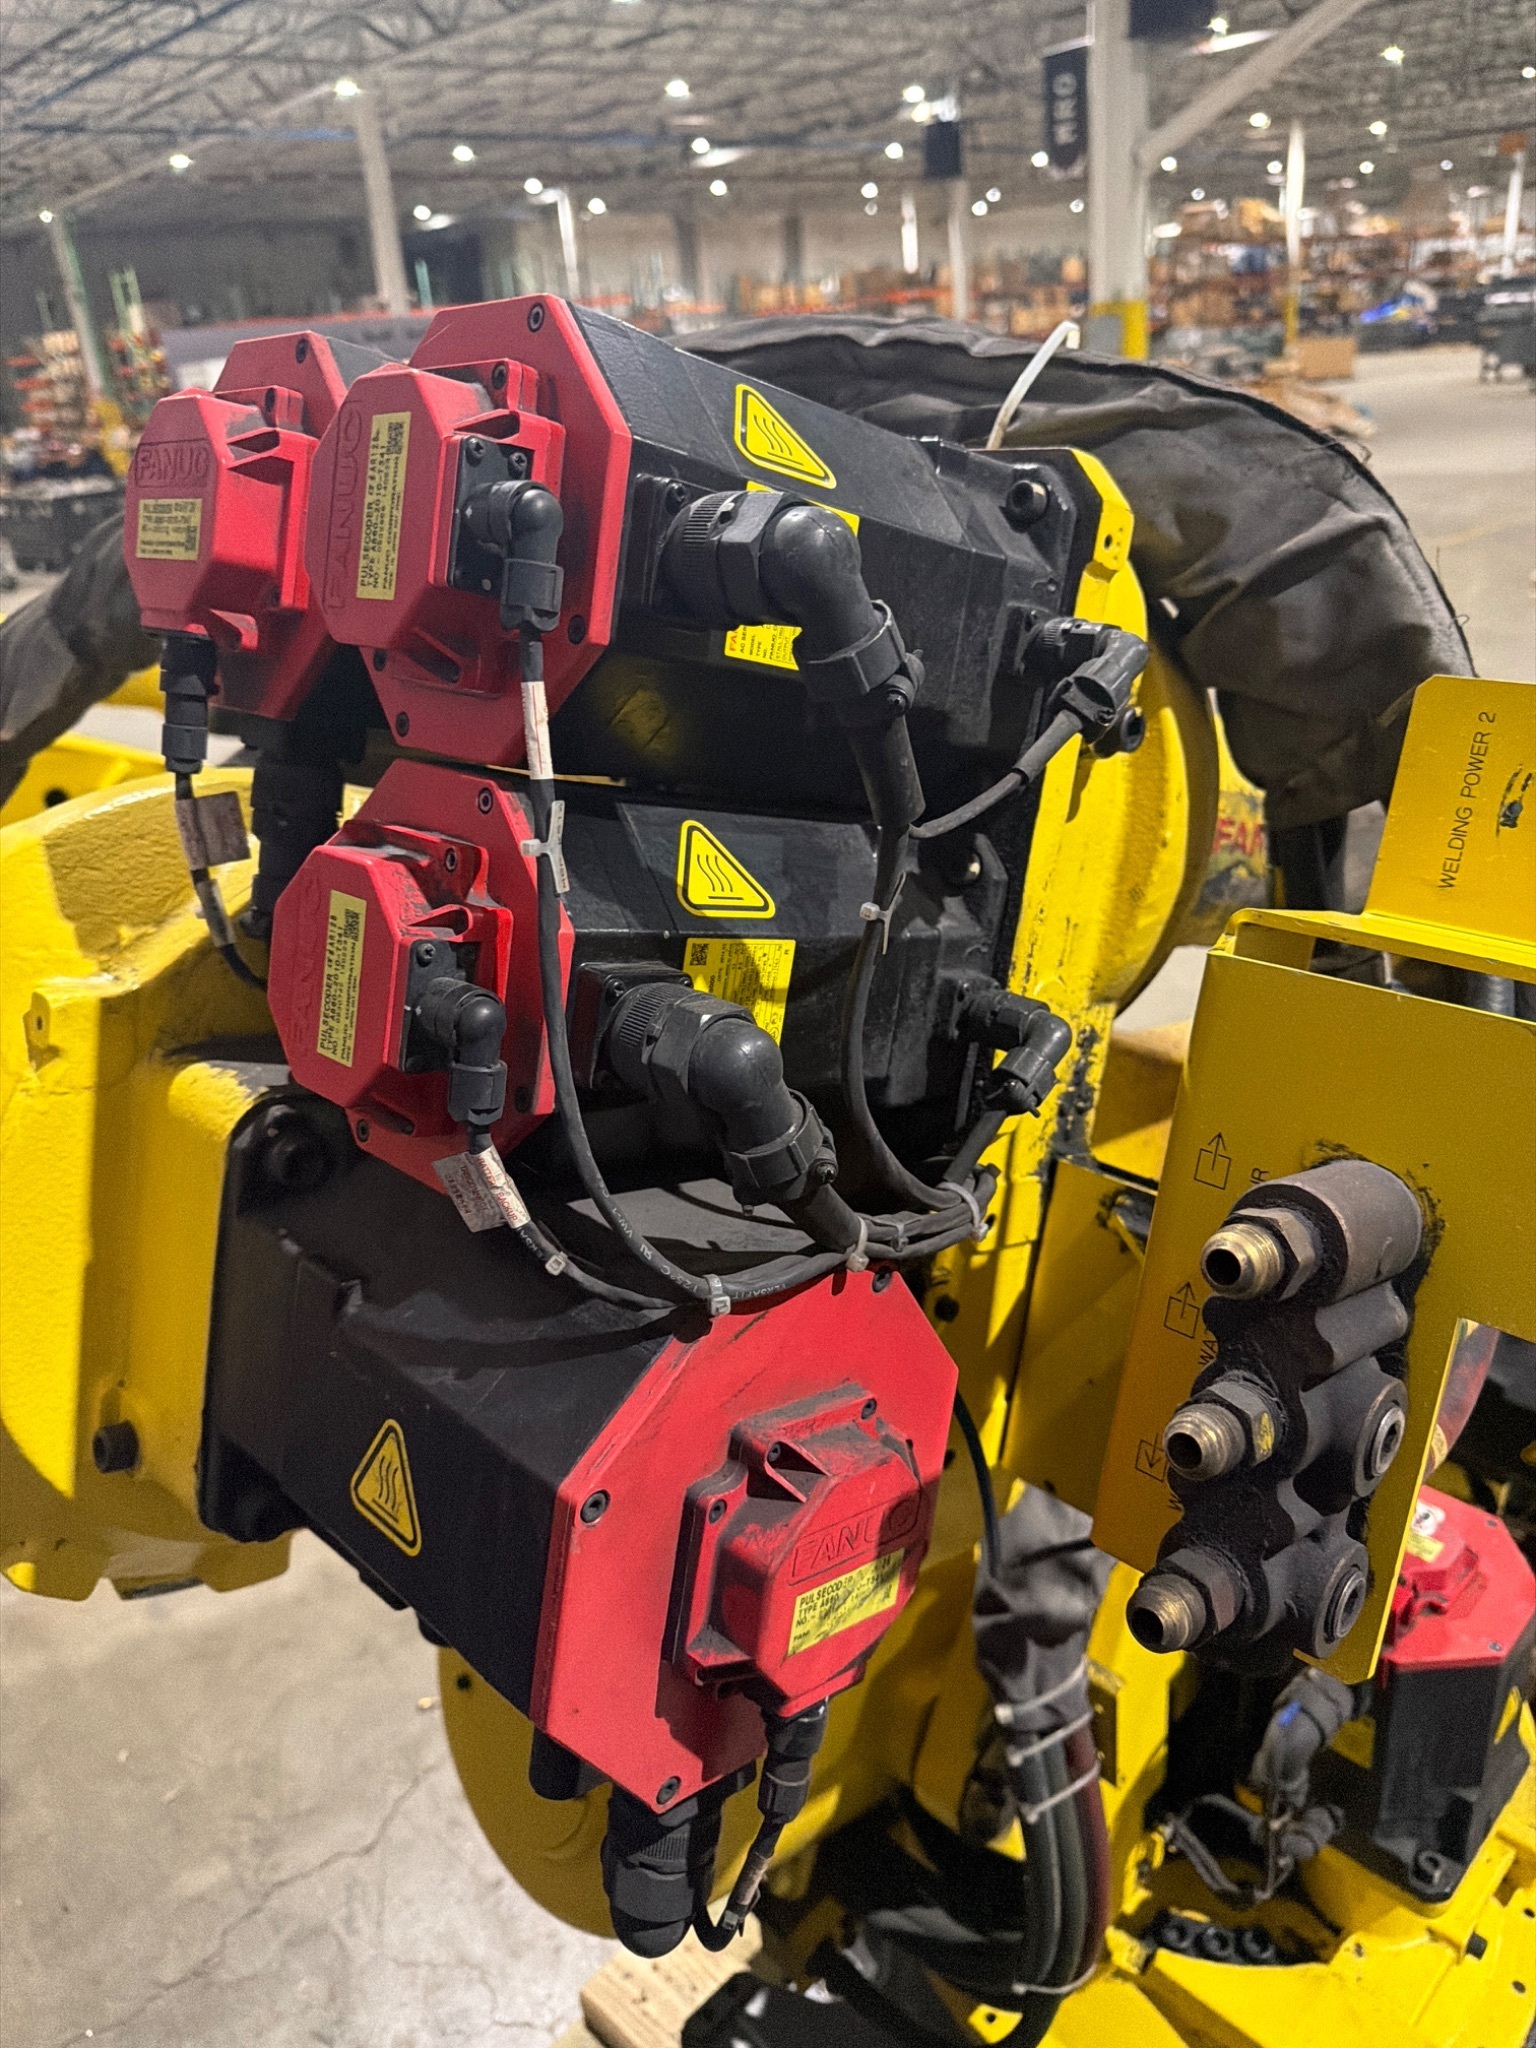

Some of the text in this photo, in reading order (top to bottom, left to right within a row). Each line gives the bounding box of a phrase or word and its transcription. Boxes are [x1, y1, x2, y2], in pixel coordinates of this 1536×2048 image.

[360, 502, 374, 586] PULSECODER
[367, 557, 375, 586] TYPE
[1437, 711, 1496, 889] WELDING POWER 2
[319, 972, 332, 1050] PULSECODER
[326, 1024, 334, 1051] TYPE
[496, 1192, 518, 1221] BACKUP
[611, 1207, 633, 1239] VW-1
[797, 1601, 817, 1618] TYPE
